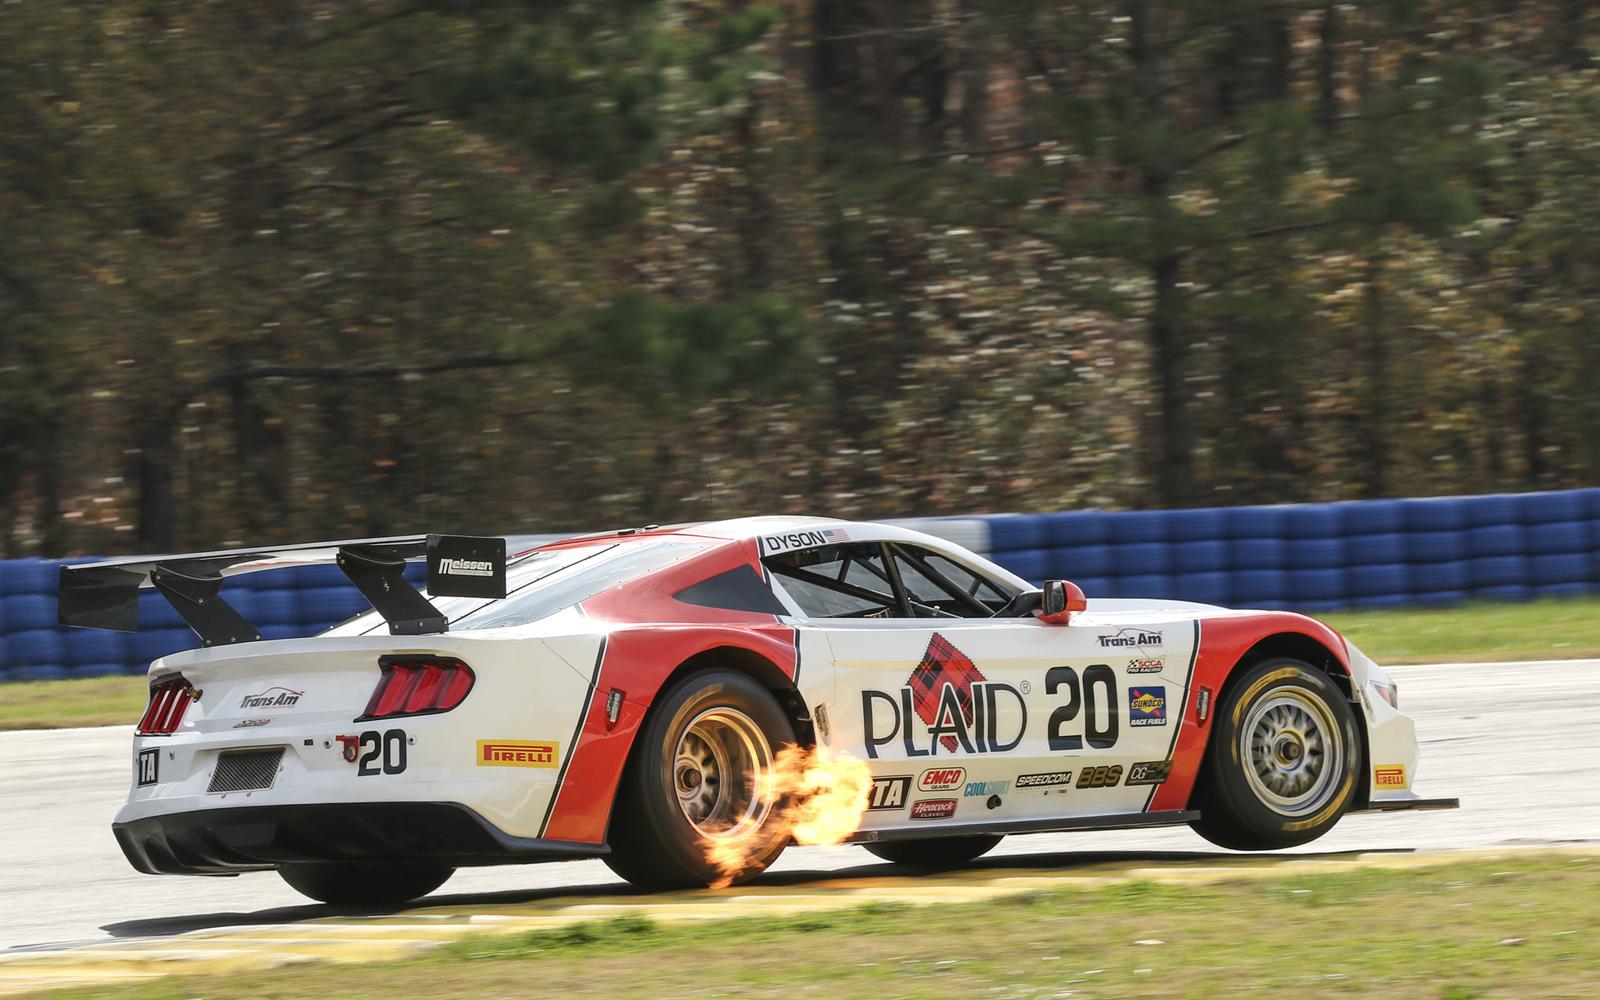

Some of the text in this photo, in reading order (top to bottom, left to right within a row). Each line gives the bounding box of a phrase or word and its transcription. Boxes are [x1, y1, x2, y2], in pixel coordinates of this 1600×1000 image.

[766, 531, 827, 551] DYSON
[438, 558, 493, 575] Meissen
[1098, 632, 1163, 648] Trans Am
[1138, 659, 1163, 667] SCCA
[240, 692, 300, 709] Trans Am
[1045, 664, 1119, 751] 20
[1132, 699, 1162, 709] SUNOCO
[861, 682, 1028, 759] PLAID
[1146, 718, 1167, 726] FUELS
[358, 728, 408, 776] 20
[483, 744, 553, 763] PIRELLI
[140, 752, 157, 783] TA
[922, 769, 962, 786] EMCO
[1017, 773, 1071, 786] SPEEDCOM
[1076, 765, 1123, 789] BBS
[1376, 768, 1404, 785] PIRELLI
[872, 779, 904, 807] TA
[914, 801, 954, 815] Heacock
